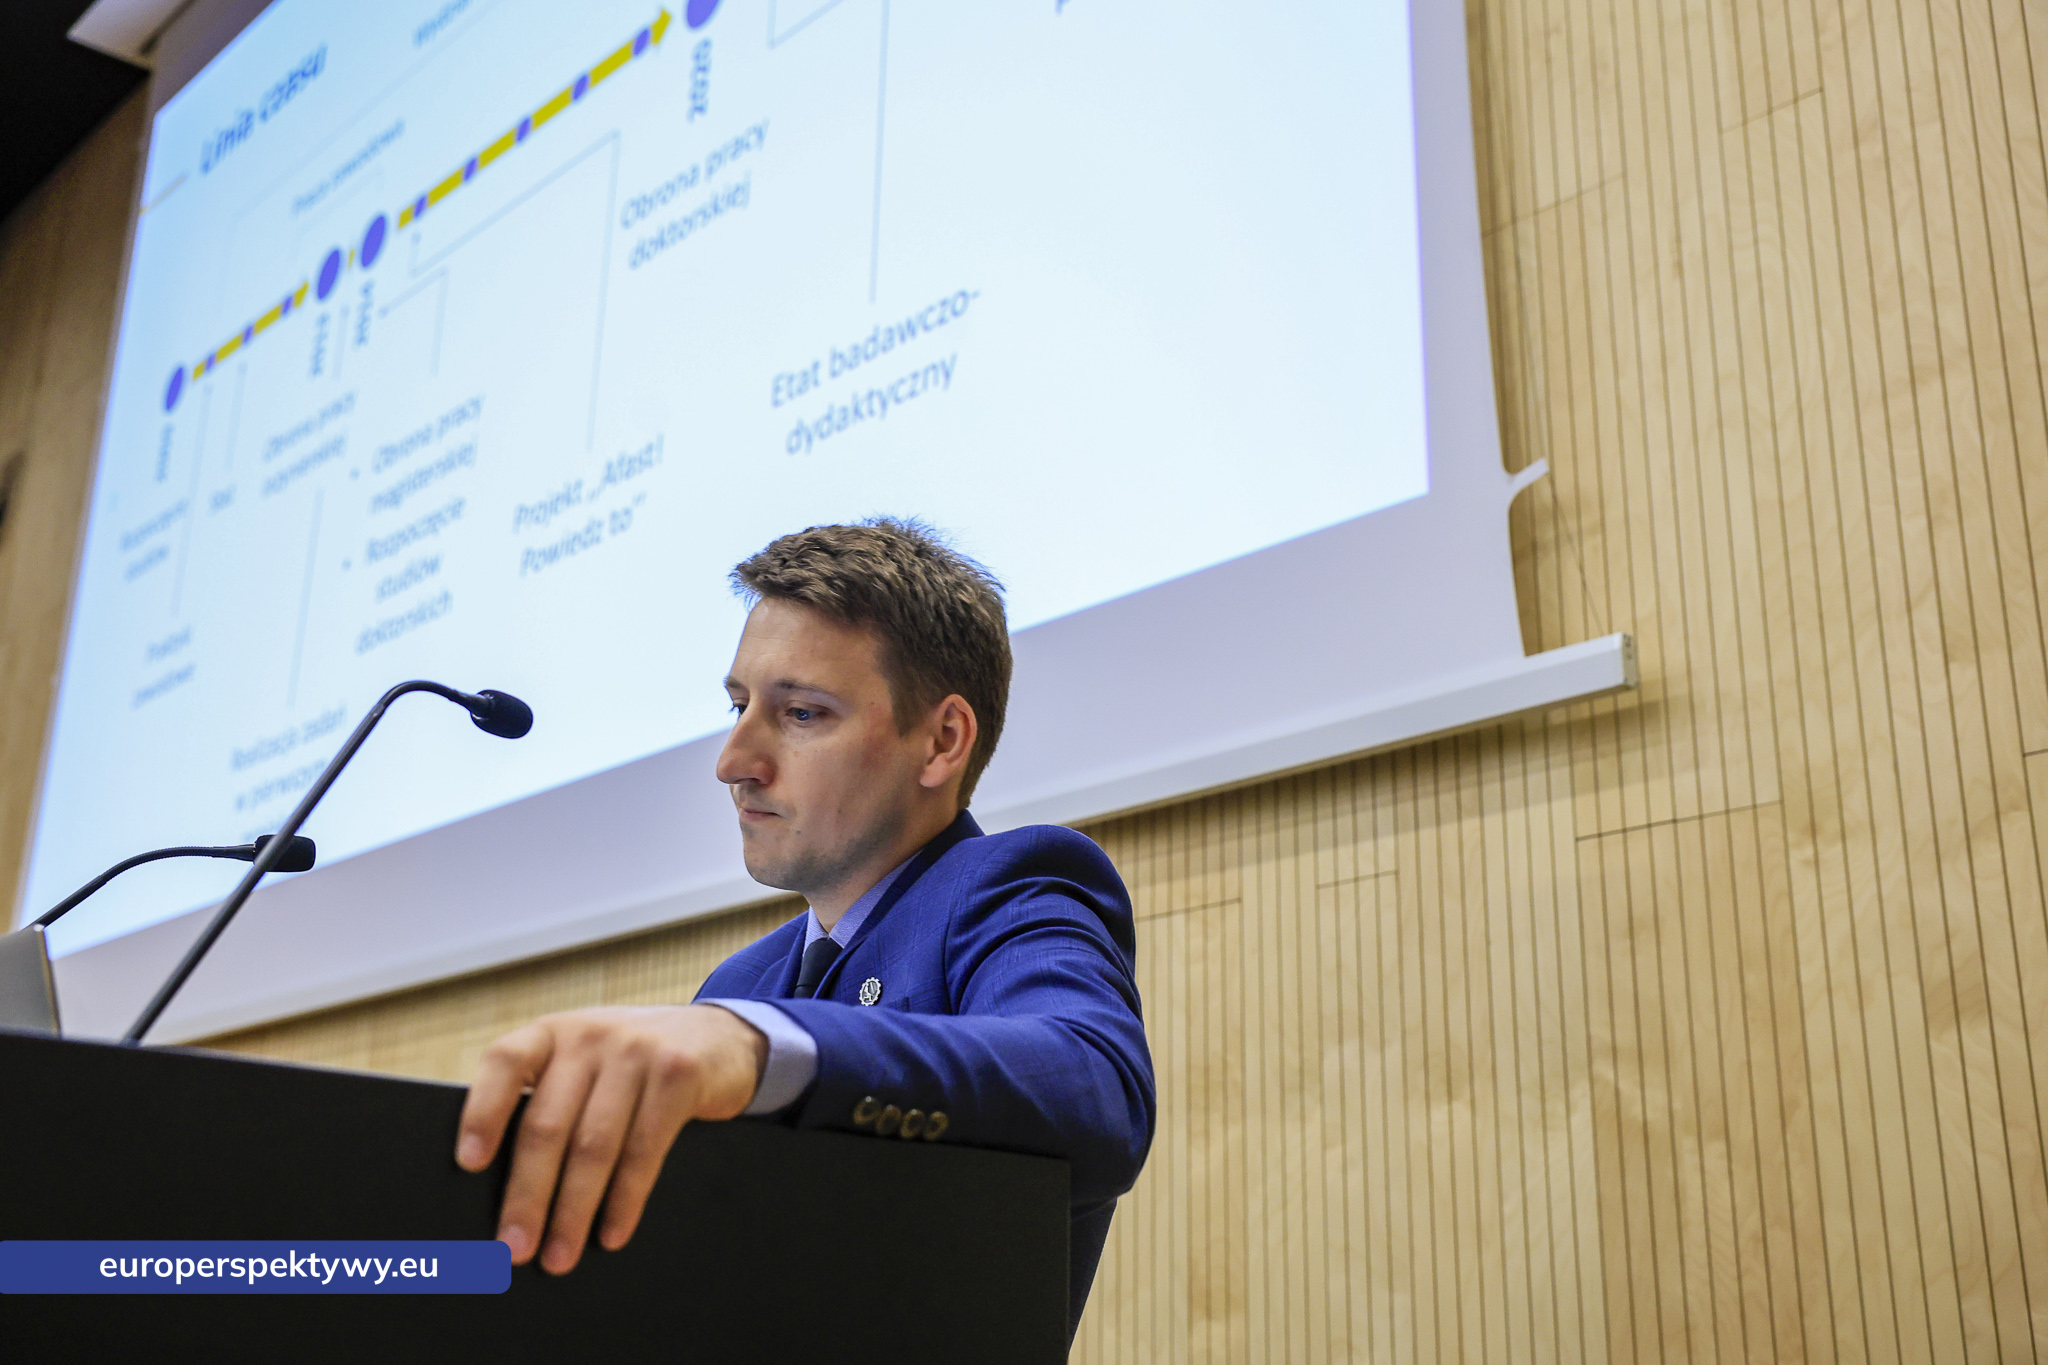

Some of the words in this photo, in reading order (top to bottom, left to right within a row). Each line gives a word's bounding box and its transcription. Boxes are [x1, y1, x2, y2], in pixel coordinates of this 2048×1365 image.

[620, 163, 700, 230] Obrona
[704, 118, 770, 185] pracy
[629, 171, 751, 270] doktorskiej
[771, 358, 822, 408] Etat
[828, 289, 981, 380] badawczo-
[786, 351, 958, 455] dydaktyczny
